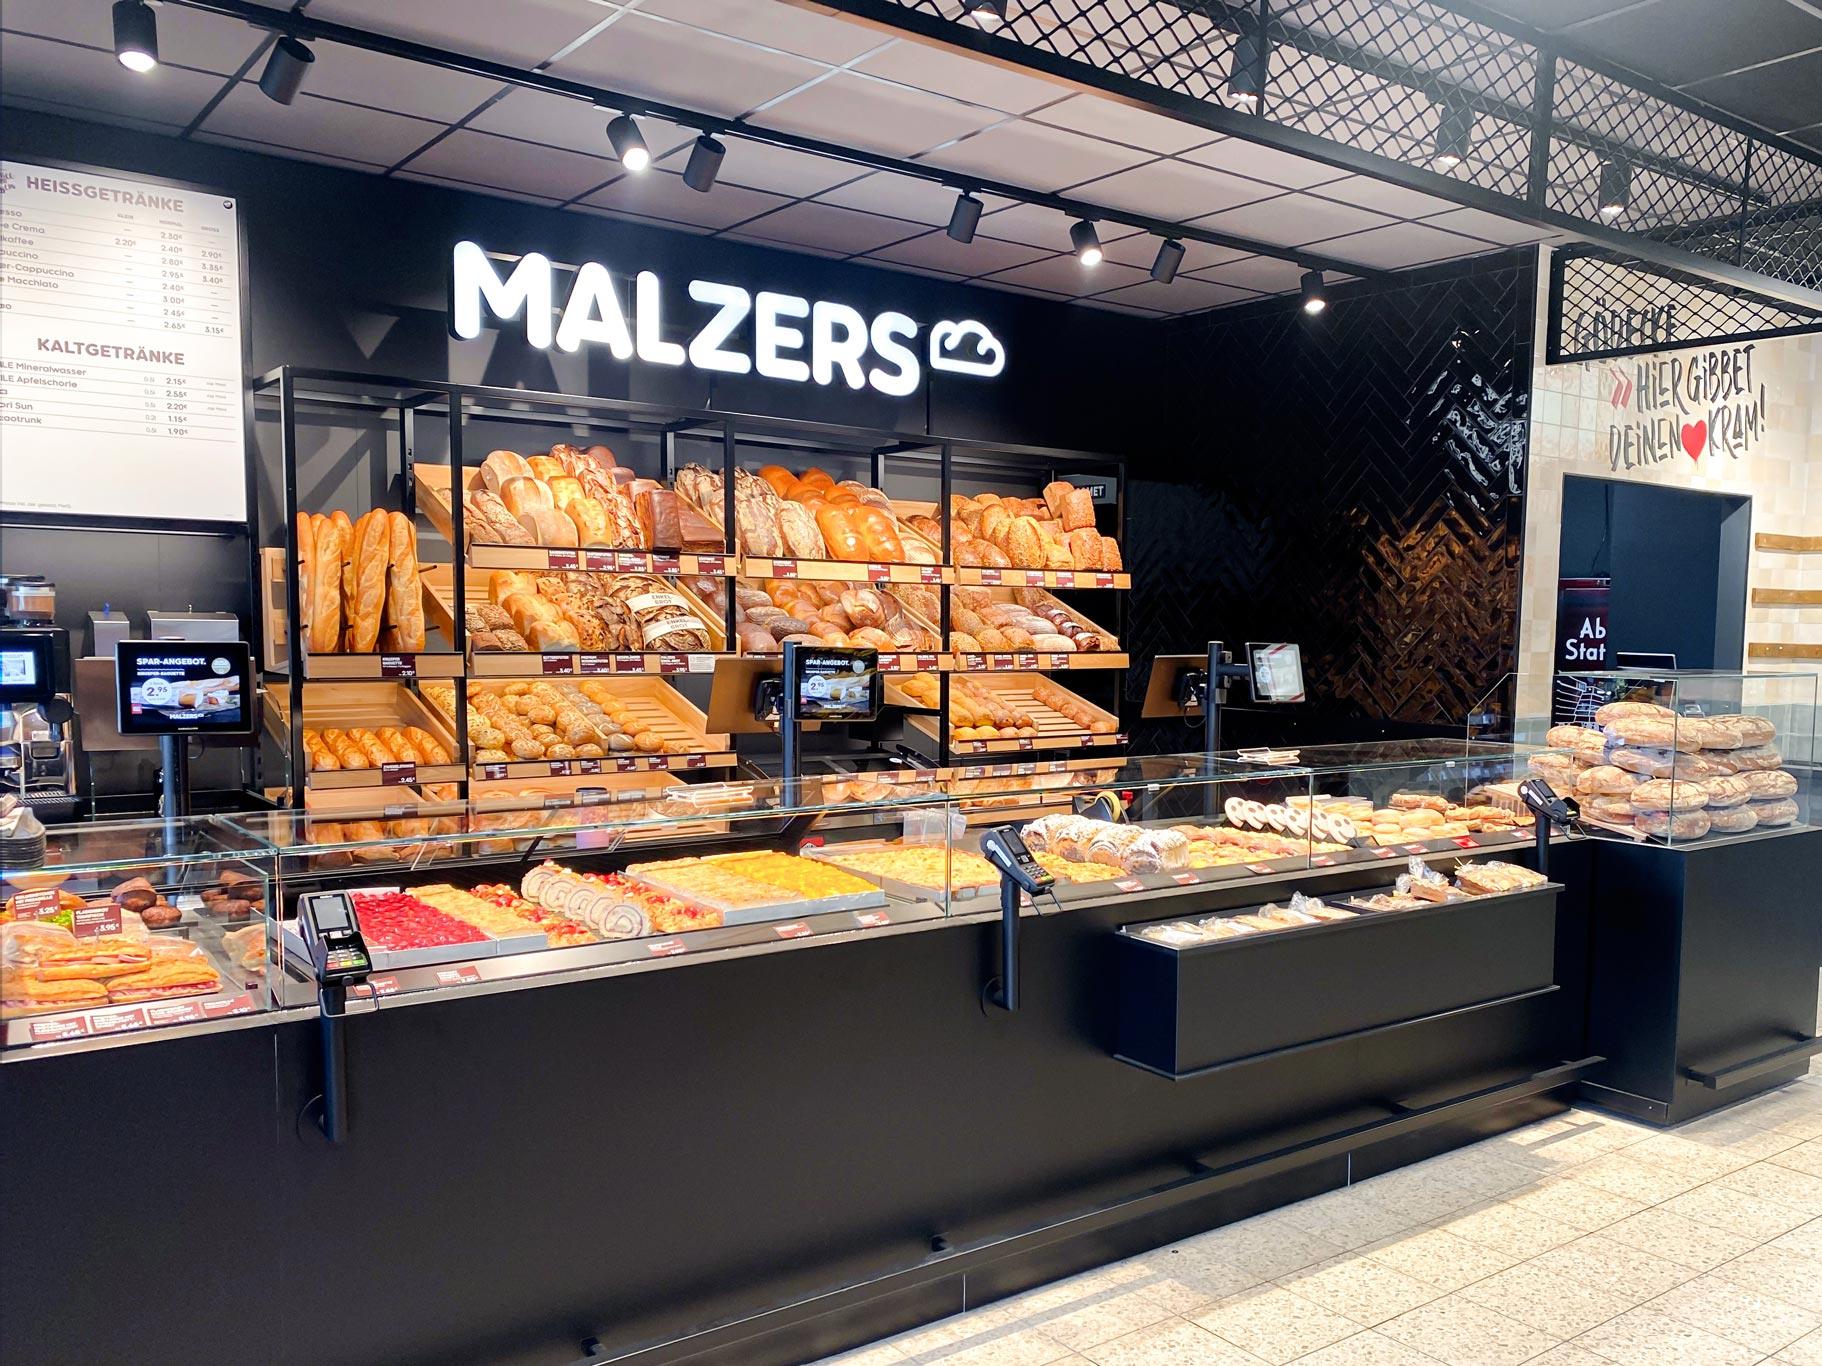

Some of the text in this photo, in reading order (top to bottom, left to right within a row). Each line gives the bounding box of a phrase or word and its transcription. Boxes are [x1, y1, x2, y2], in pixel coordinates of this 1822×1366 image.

[26, 175, 184, 213] HEISSGETRÄNKE
[12, 222, 45, 234] Crema
[7, 275, 59, 289] Macchiato
[453, 239, 921, 397] MALZERS
[37, 336, 185, 366] KALTGETRÄNKE
[16, 362, 87, 376] Mineralwasser
[166, 377, 187, 386] 2.15€
[17, 375, 78, 389] Apfelschorle
[166, 390, 188, 399] 2.55€
[15, 402, 33, 411] Sun
[168, 415, 188, 424] 1.15€
[166, 402, 188, 411] 2.20€
[168, 428, 189, 437] 1.90€
[1579, 616, 1608, 639] Ab
[1565, 638, 1607, 661] Stat
[146, 686, 168, 697] 2.95
